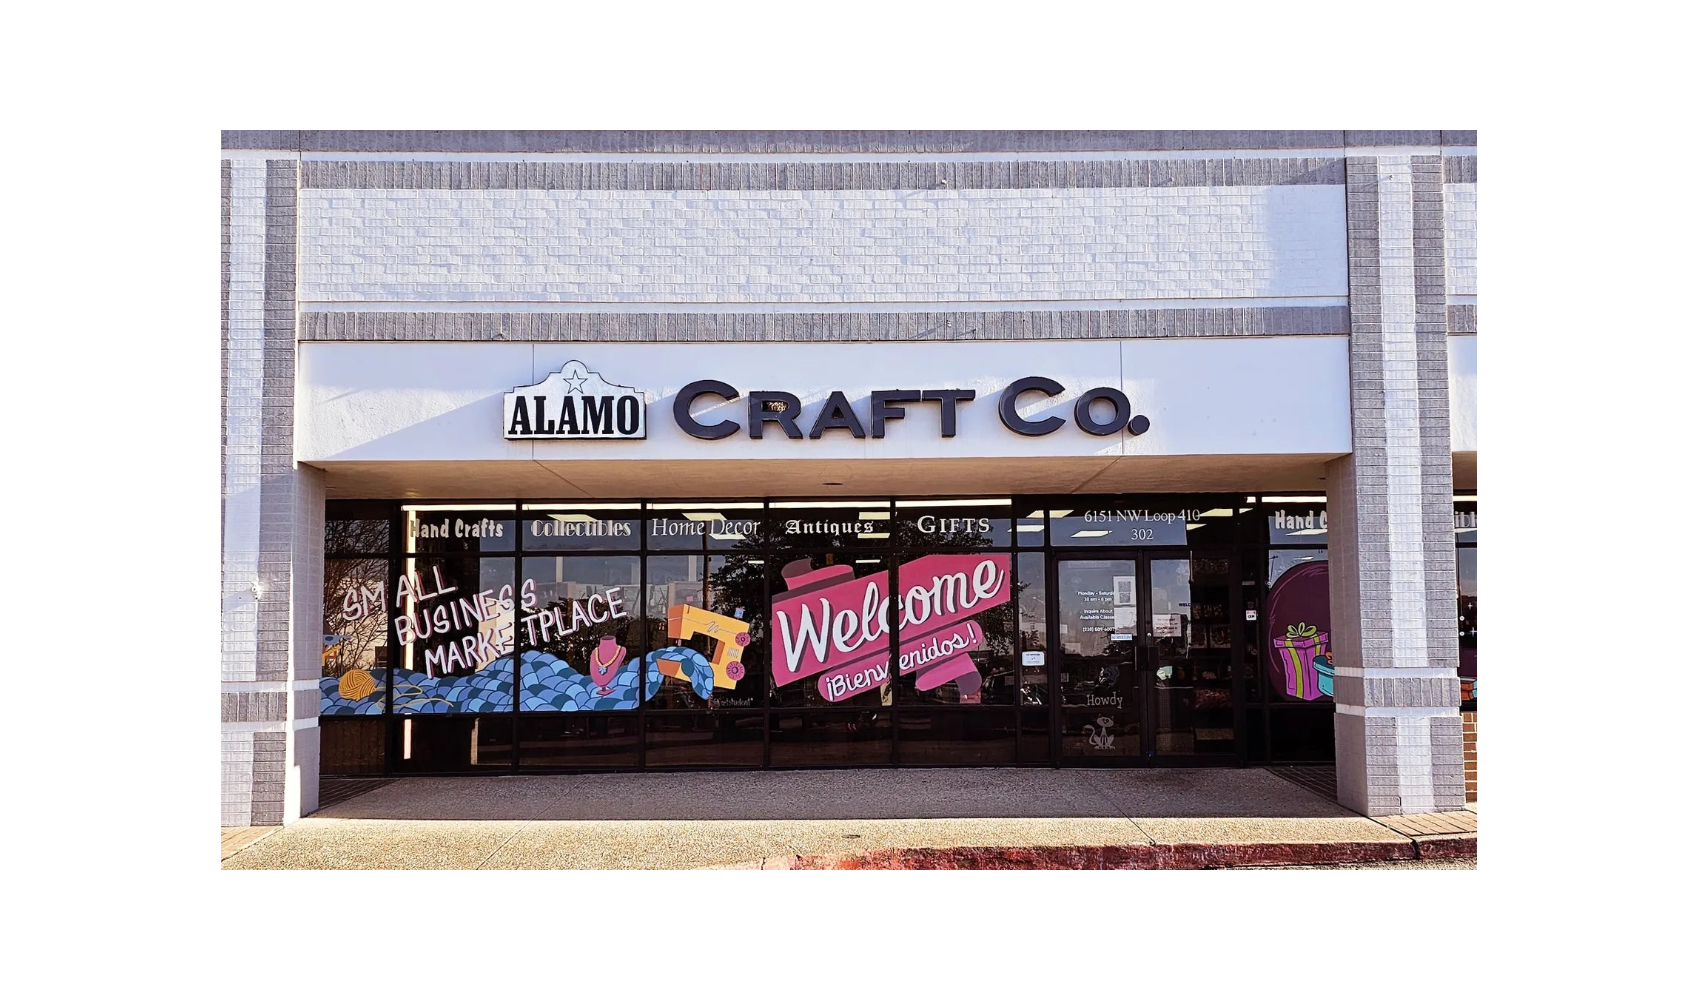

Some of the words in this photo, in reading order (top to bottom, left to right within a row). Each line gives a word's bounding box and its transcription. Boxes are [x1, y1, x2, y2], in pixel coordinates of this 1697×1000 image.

[508, 394, 640, 436] ALAMO
[1084, 509, 1114, 523] 6151
[1116, 509, 1143, 522] NW
[1144, 509, 1176, 525] Loop
[1178, 508, 1201, 522] 410
[1274, 510, 1315, 529] Hand
[408, 518, 450, 538] Hand
[454, 518, 504, 538] Crafts
[530, 519, 632, 537] Collectibles
[651, 518, 706, 537] Home
[709, 517, 761, 536] Decor
[784, 518, 875, 537] Antiques
[1130, 528, 1154, 540] 302
[394, 578, 537, 647] BUSINESS
[777, 559, 1004, 673] Welcome
[1086, 692, 1123, 709] Howdy
